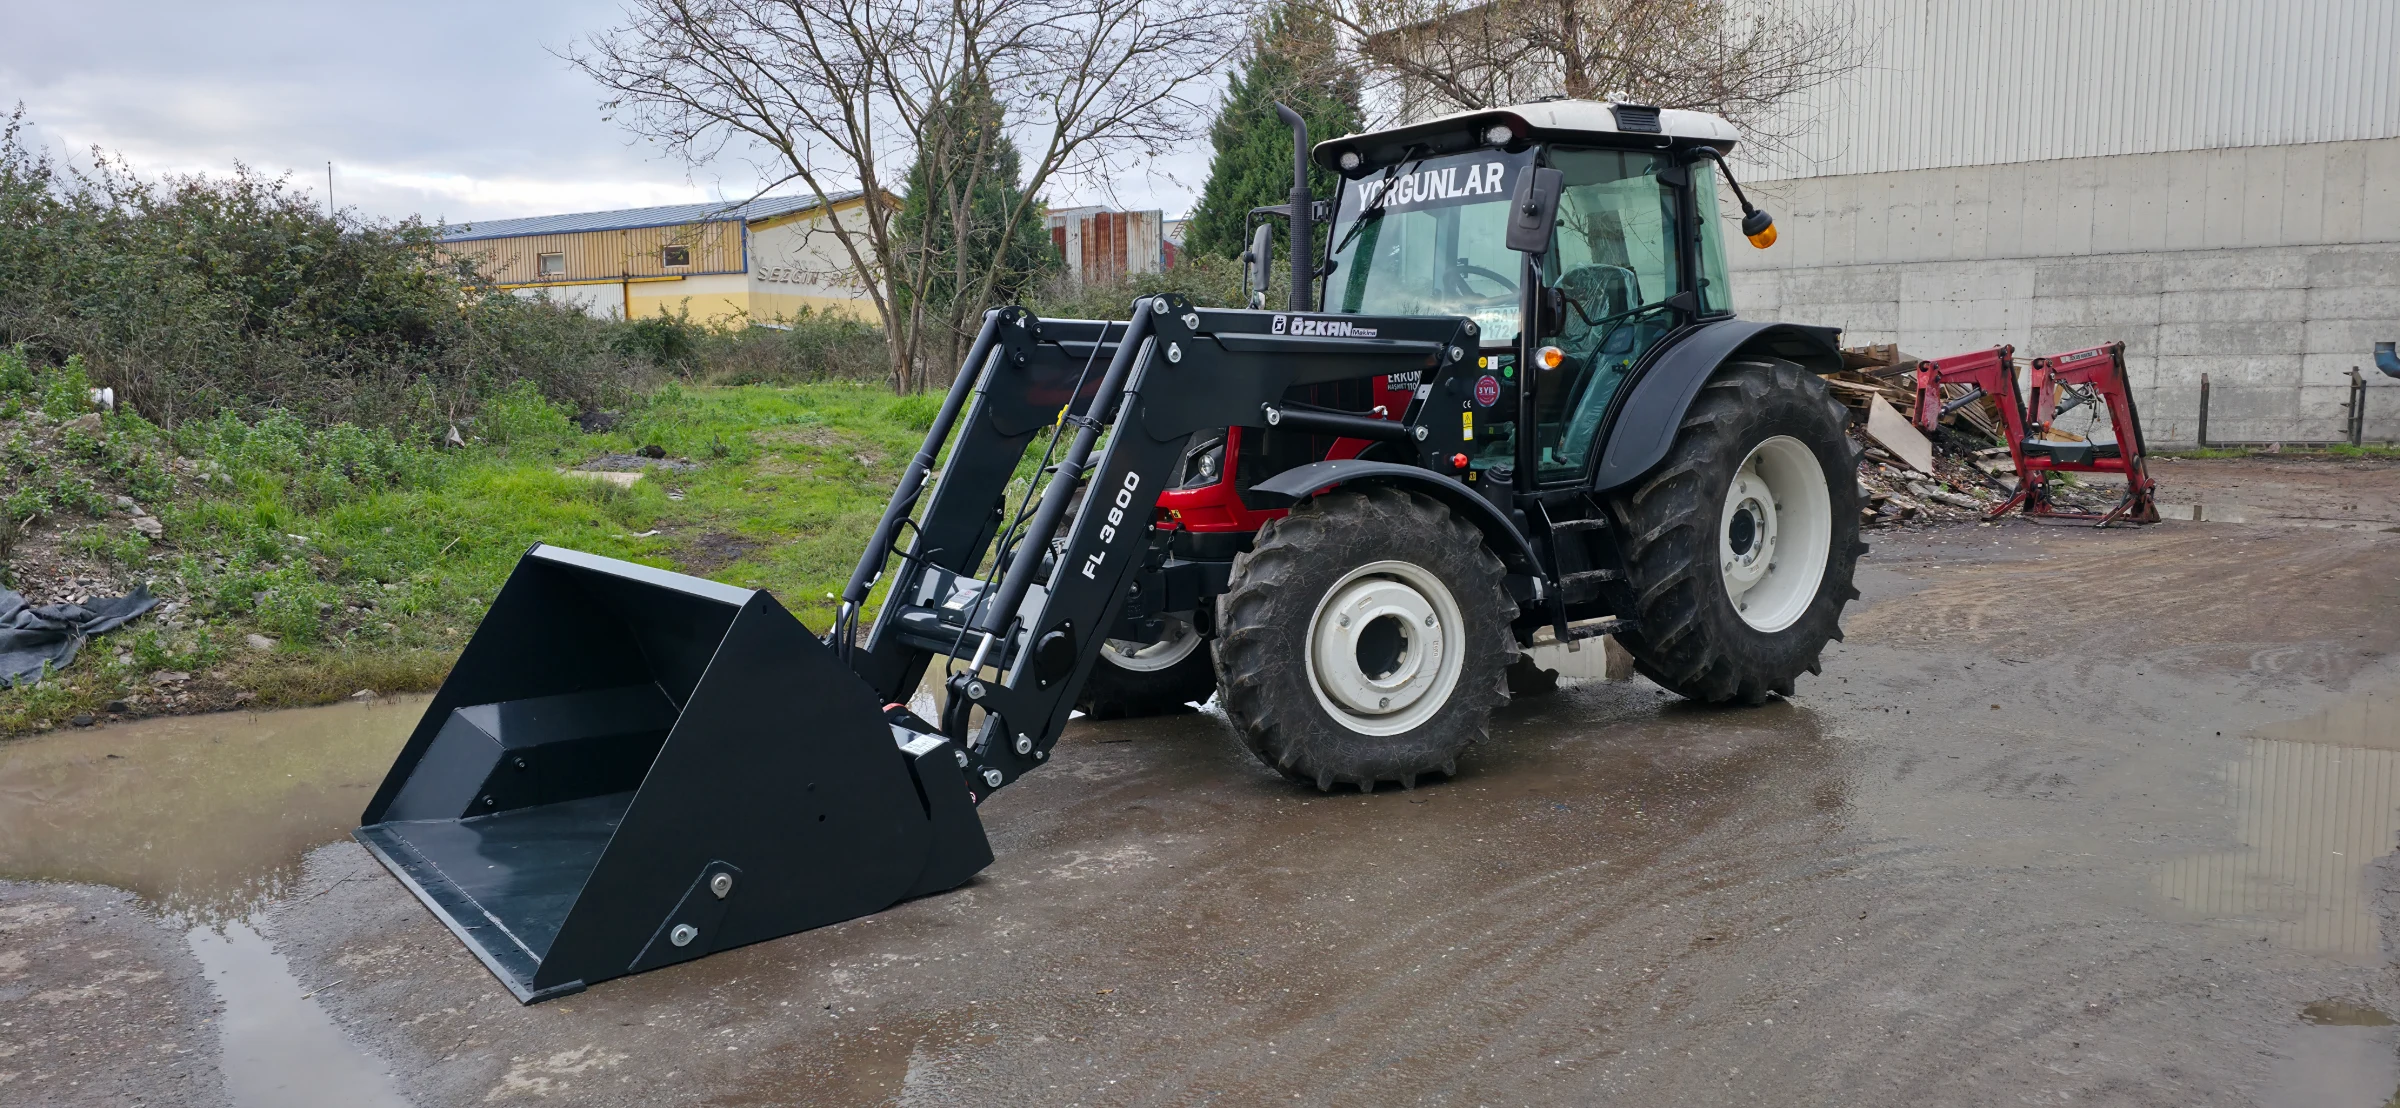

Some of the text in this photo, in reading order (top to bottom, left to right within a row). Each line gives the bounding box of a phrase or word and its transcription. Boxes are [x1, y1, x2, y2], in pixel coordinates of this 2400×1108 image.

[1358, 162, 1504, 211] YORGUNLAR
[1291, 317, 1353, 337] ÖZKAN
[1387, 370, 1422, 383] ERKUN
[1082, 471, 1140, 580] FL 3800
